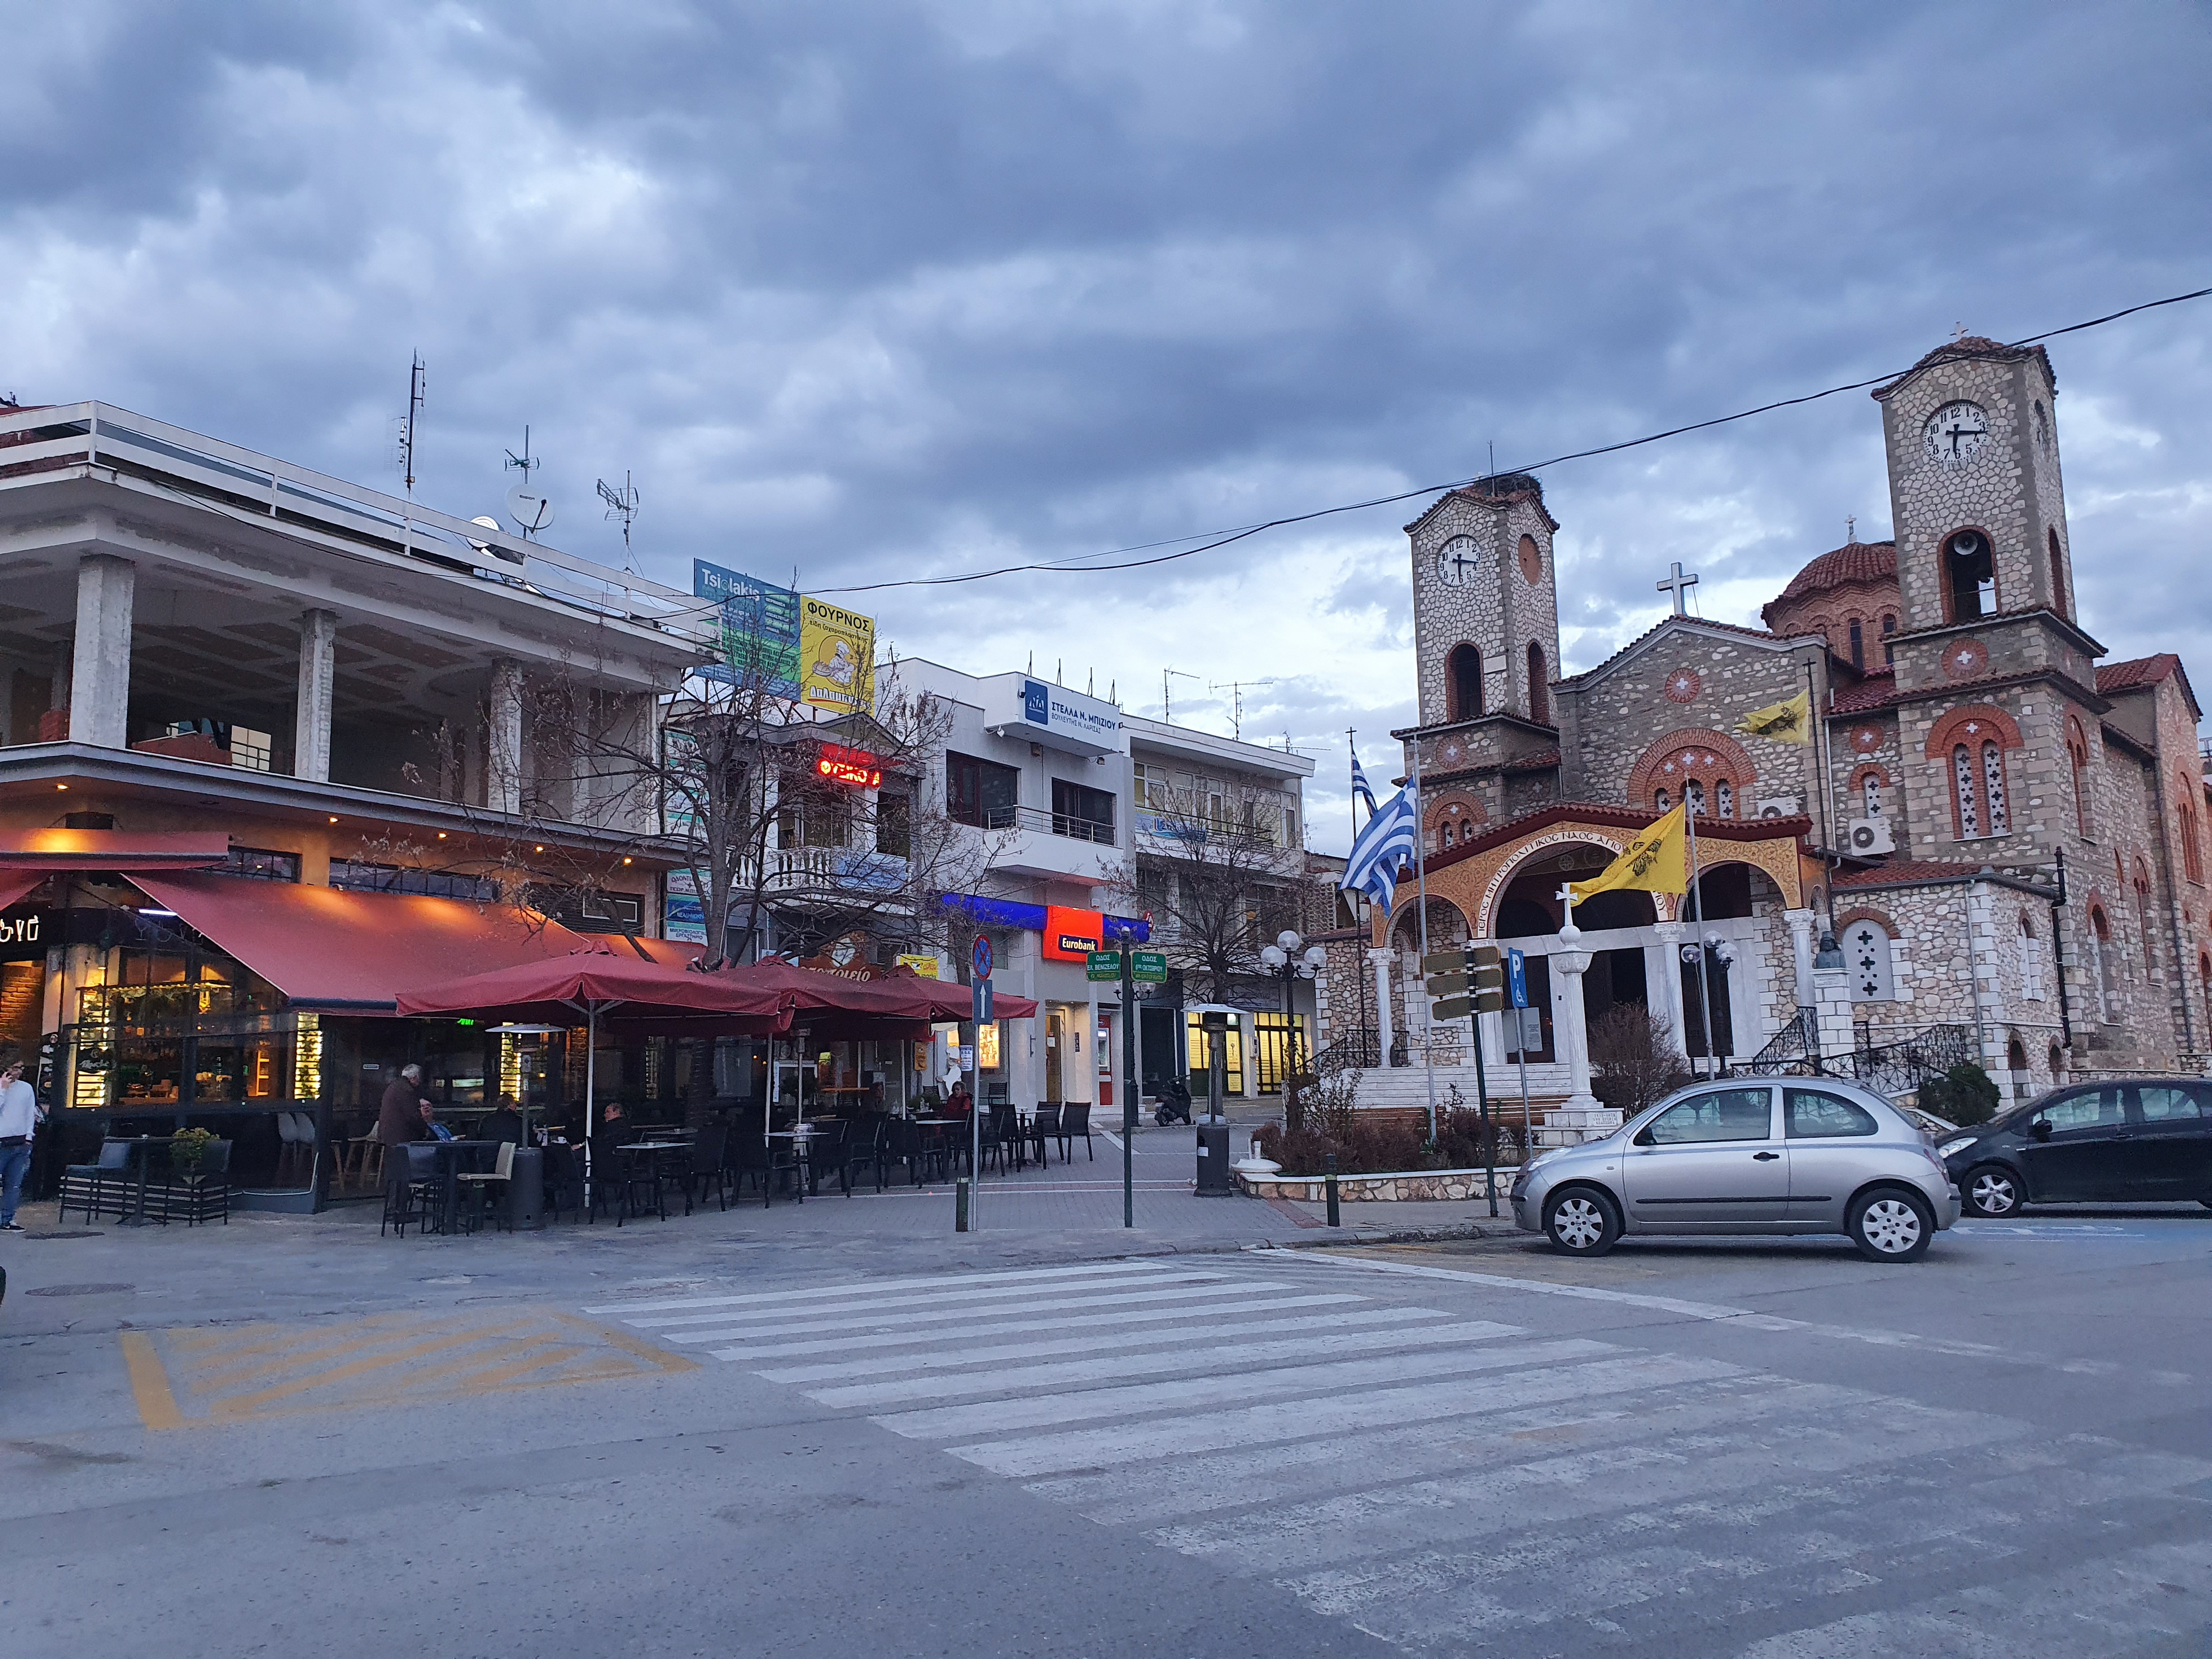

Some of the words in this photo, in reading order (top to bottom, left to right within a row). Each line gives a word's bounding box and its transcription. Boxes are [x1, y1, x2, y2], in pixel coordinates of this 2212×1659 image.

[1950, 407, 1961, 419] 12
[1966, 407, 1969, 417] 1
[1973, 412, 1980, 422] 2
[1940, 412, 1946, 424] 11
[1930, 423, 1939, 435] 10
[1979, 421, 1985, 432] 3
[1927, 436, 1933, 447] 9
[1973, 433, 1979, 443] 4
[1933, 444, 1939, 455] 8
[1943, 448, 1950, 459] 7
[1954, 448, 1961, 459] 6
[1965, 443, 1972, 454] 5
[1449, 543, 1454, 552] 11
[1456, 539, 1463, 549] 12
[1466, 539, 1470, 548] 1
[1472, 544, 1477, 552] 2
[1442, 552, 1448, 562] 10
[1476, 552, 1481, 561] 3
[1440, 562, 1444, 571] 9
[1472, 562, 1477, 571] 4
[1443, 571, 1448, 579] 8
[1451, 574, 1455, 583] 7
[1459, 574, 1463, 583] 6
[1466, 571, 1471, 580] 5
[808, 601, 870, 632] ΦΟΥΡΝΟΣ
[822, 624, 868, 644] ζαχαροπλαστκής
[1051, 702, 1078, 718] ΣΤΕΛΛΑ
[1080, 710, 1087, 721] Ν.
[1088, 714, 1116, 730] ΜΠΙΖΙΟΥ
[1051, 712, 1077, 726] ΒΟΥΛΕΥΤΗΣ
[1084, 724, 1101, 734] ΛΑΡΙΣΑΣ
[1596, 835, 1624, 851] ΑΓΙΟ
[1062, 938, 1096, 951] Eurobank
[1511, 954, 1521, 979] P
